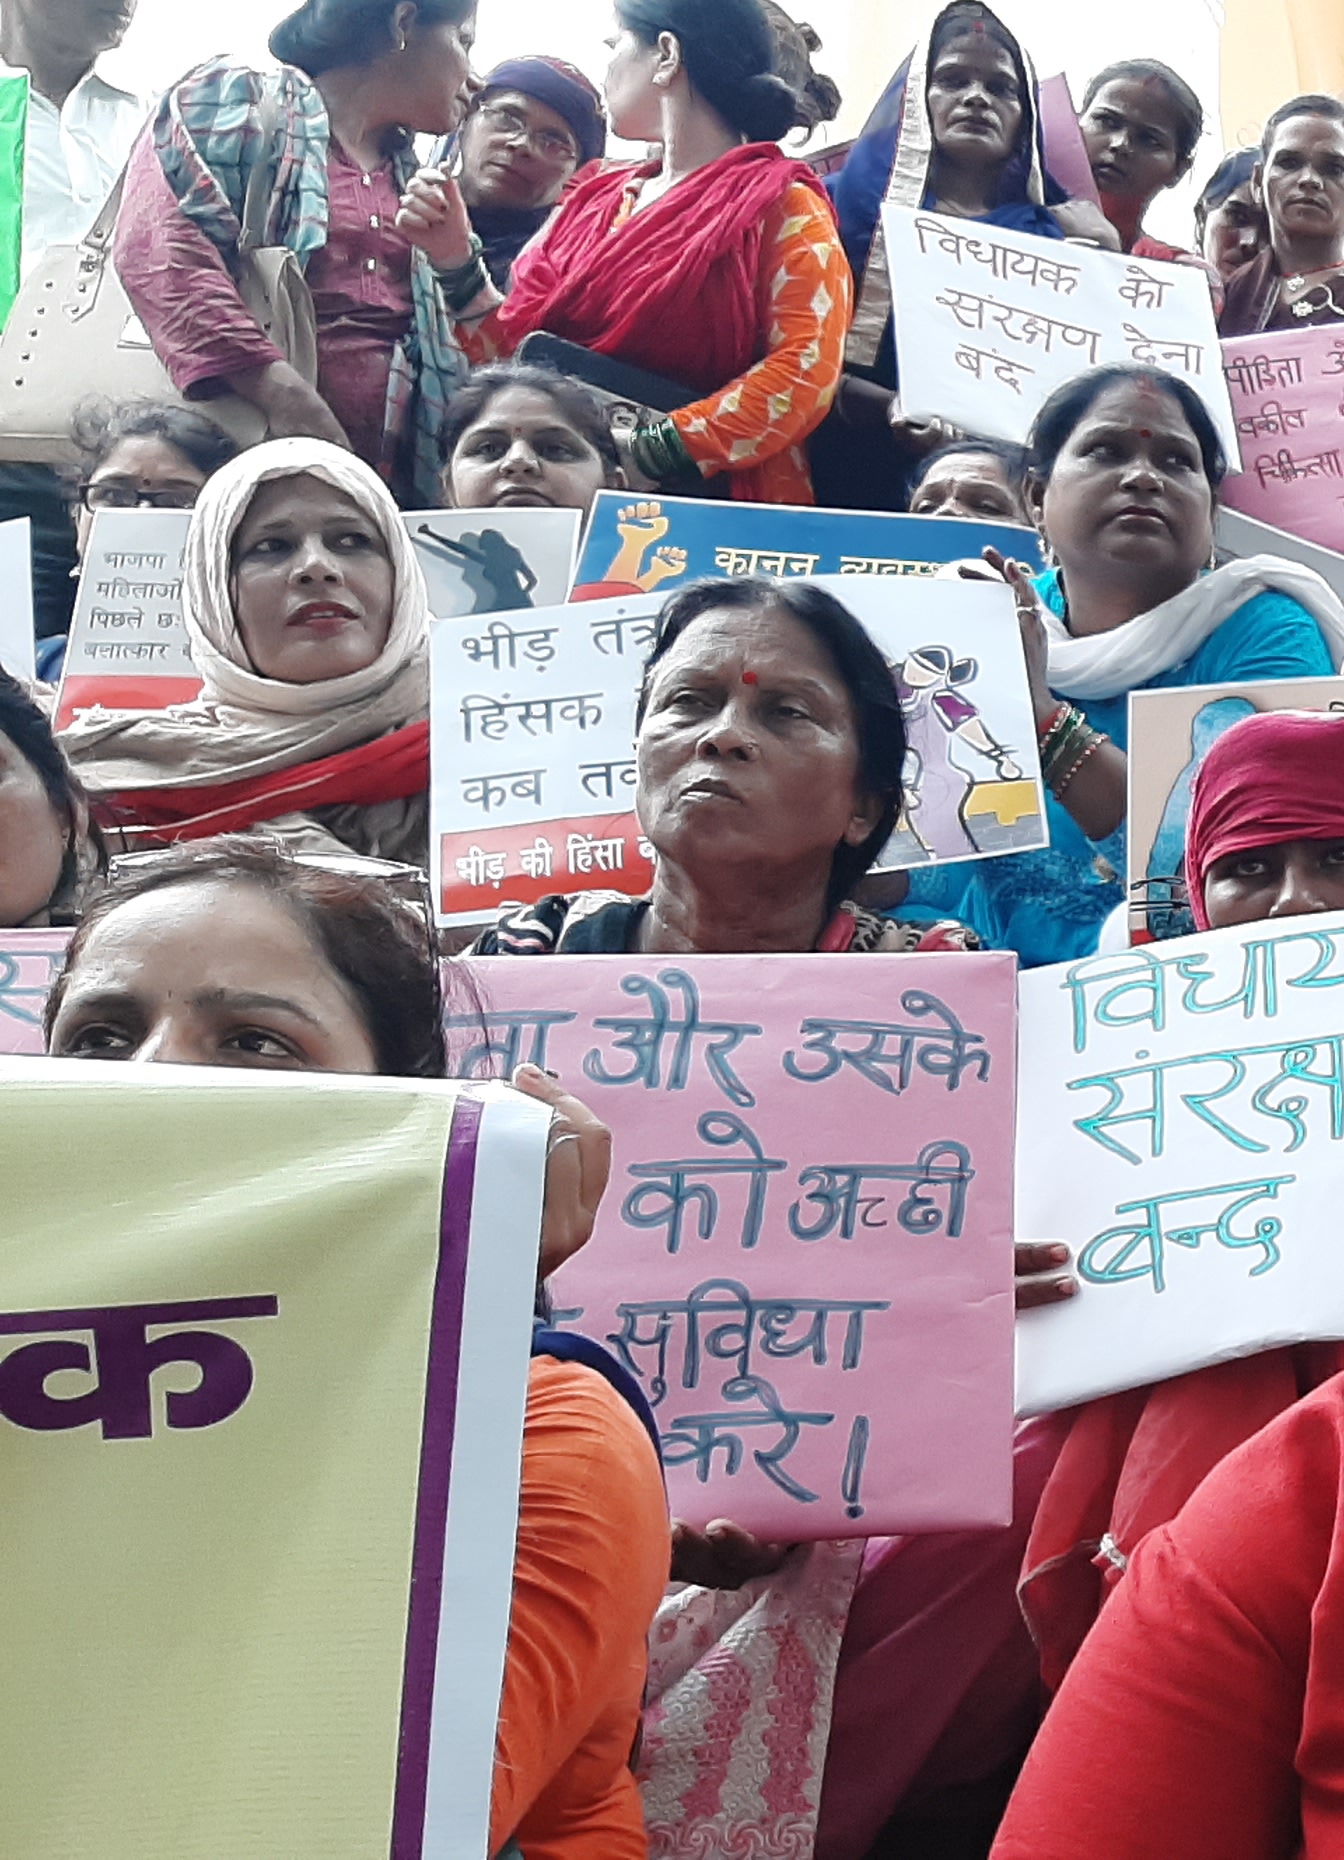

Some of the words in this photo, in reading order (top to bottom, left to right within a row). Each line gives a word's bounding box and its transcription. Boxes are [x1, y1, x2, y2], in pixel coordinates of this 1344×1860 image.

[914, 218, 1081, 296] विधायक
[1117, 265, 1175, 309] को
[934, 288, 1102, 364] संरक्षण
[1122, 321, 1204, 376] देना
[953, 342, 1037, 396] बंद
[102, 552, 167, 569] भाजपा
[460, 621, 560, 674] भीड़
[459, 692, 605, 744] हिंसक
[460, 768, 548, 813] कब
[456, 845, 507, 890] भीड़
[520, 837, 554, 880] की
[566, 833, 626, 875] हिंसा
[442, 1010, 578, 1081] ता
[582, 967, 763, 1108] और
[781, 989, 991, 1096] उसके
[621, 1110, 788, 1255] को
[1077, 1174, 1297, 1294] बन्द
[605, 1278, 892, 1406] सुविधा
